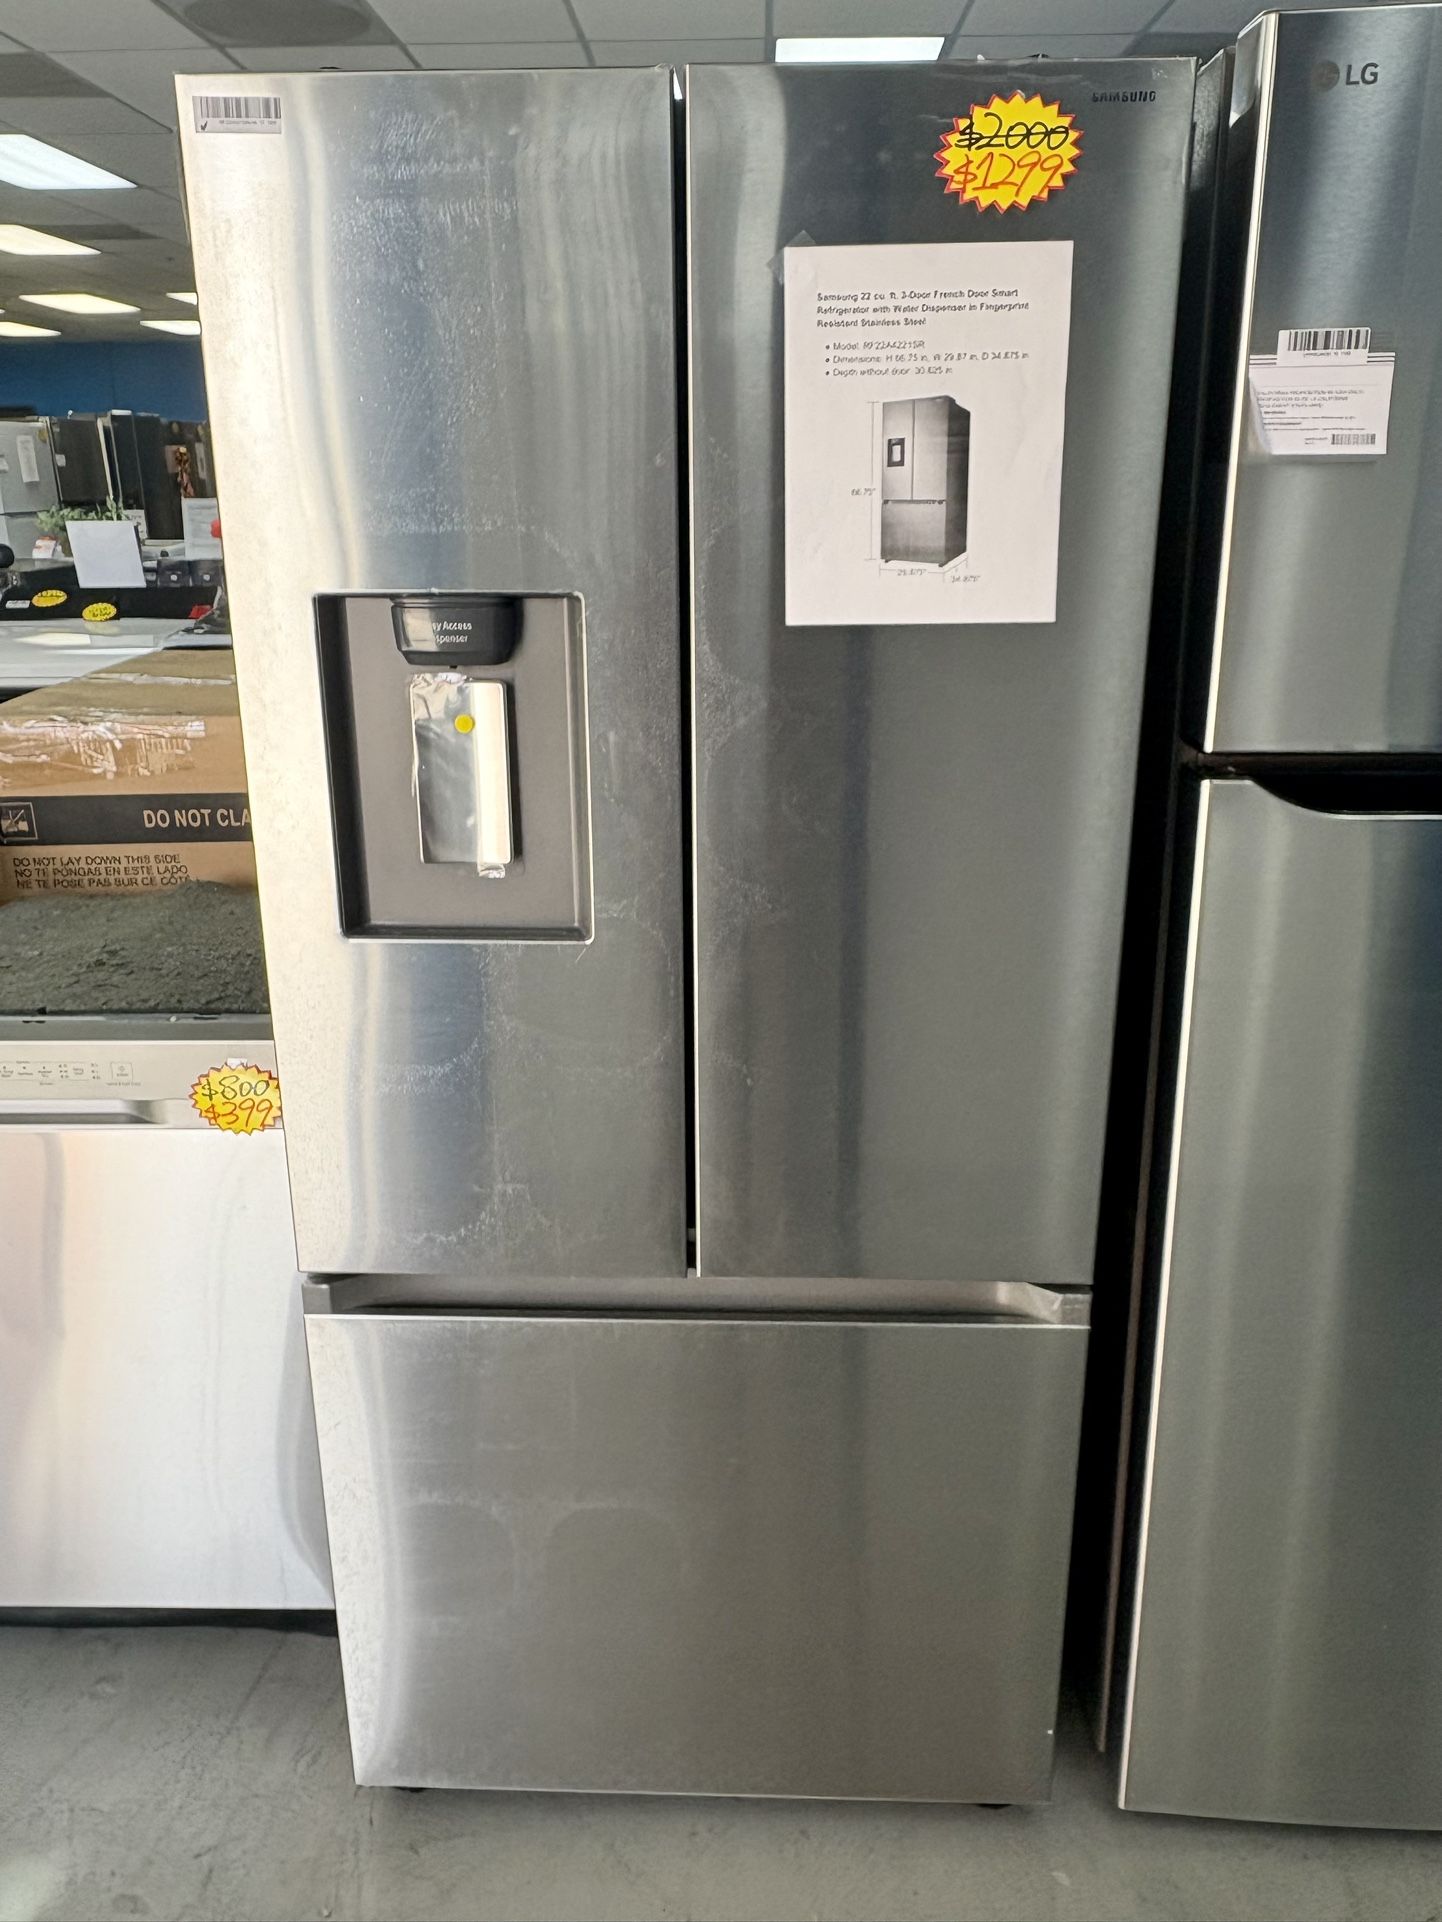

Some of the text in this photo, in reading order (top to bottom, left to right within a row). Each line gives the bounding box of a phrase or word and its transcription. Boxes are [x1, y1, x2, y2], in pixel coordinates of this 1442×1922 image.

[1345, 62, 1379, 85] LG
[1092, 91, 1156, 102] SAMSUNG
[955, 112, 1070, 151] $2000
[952, 151, 1063, 197] $1299
[817, 293, 858, 302] Samsung
[933, 290, 965, 299] French
[967, 289, 989, 298] Door
[992, 288, 1018, 298] Smart
[817, 305, 869, 316] Refrigerator
[872, 305, 891, 314] with
[893, 305, 919, 313] Water
[921, 303, 966, 313] Dispenser
[980, 302, 1029, 312] Fingerprint
[817, 317, 927, 328] Resistant Stainless Steel
[442, 621, 472, 631] Access
[143, 808, 252, 828] DO NOT CLA
[13, 854, 181, 867] DO NOT LAY DOWN THIS SIDE
[15, 868, 32, 878] NO
[35, 867, 48, 877] TE
[105, 866, 120, 876] EN
[124, 865, 153, 875] ESTE
[157, 864, 188, 874] LADO
[35, 879, 49, 889] TE
[53, 878, 85, 888] POSE
[88, 878, 112, 887] PAS
[114, 877, 139, 887] SUR
[141, 876, 157, 886] CE
[202, 1075, 270, 1101] $800
[204, 1098, 273, 1127] $399
